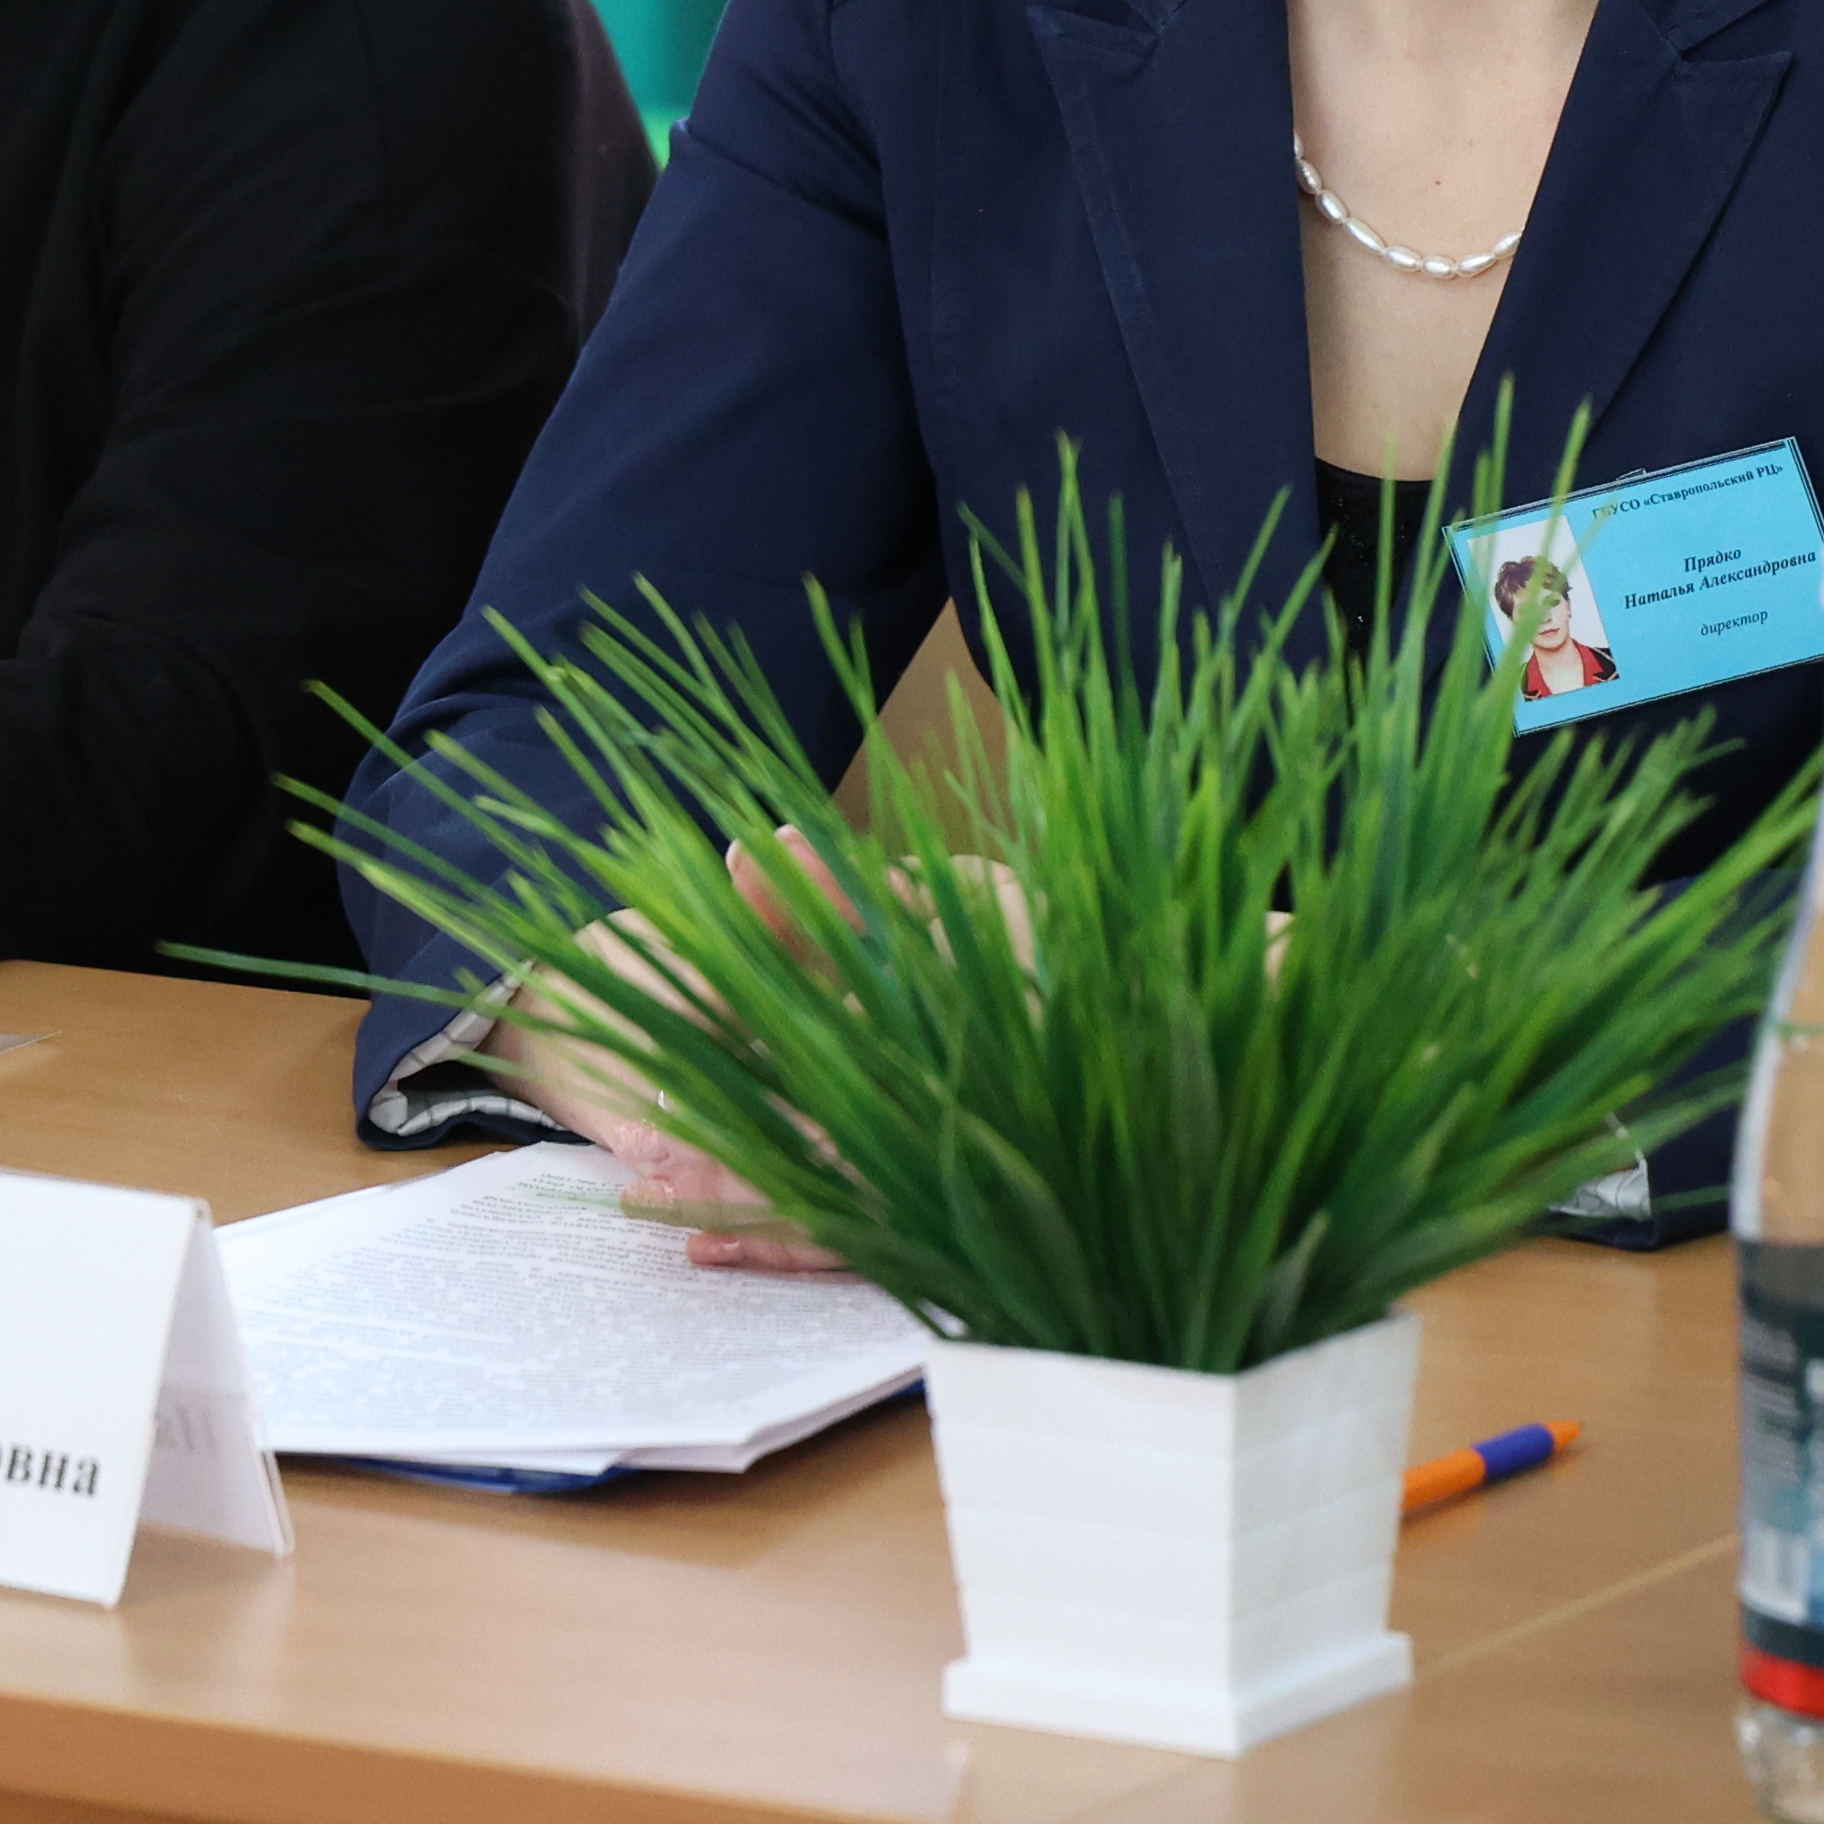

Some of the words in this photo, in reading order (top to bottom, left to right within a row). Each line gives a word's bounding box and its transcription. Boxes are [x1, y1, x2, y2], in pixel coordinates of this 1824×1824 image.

[1643, 472, 1755, 507] «Ставропольский
[1756, 462, 1784, 479] РЦ»
[1683, 548, 1742, 573] Прядко
[1624, 582, 1695, 610] Наталья
[1699, 551, 1817, 590] Александровна
[1700, 610, 1769, 636] директор
